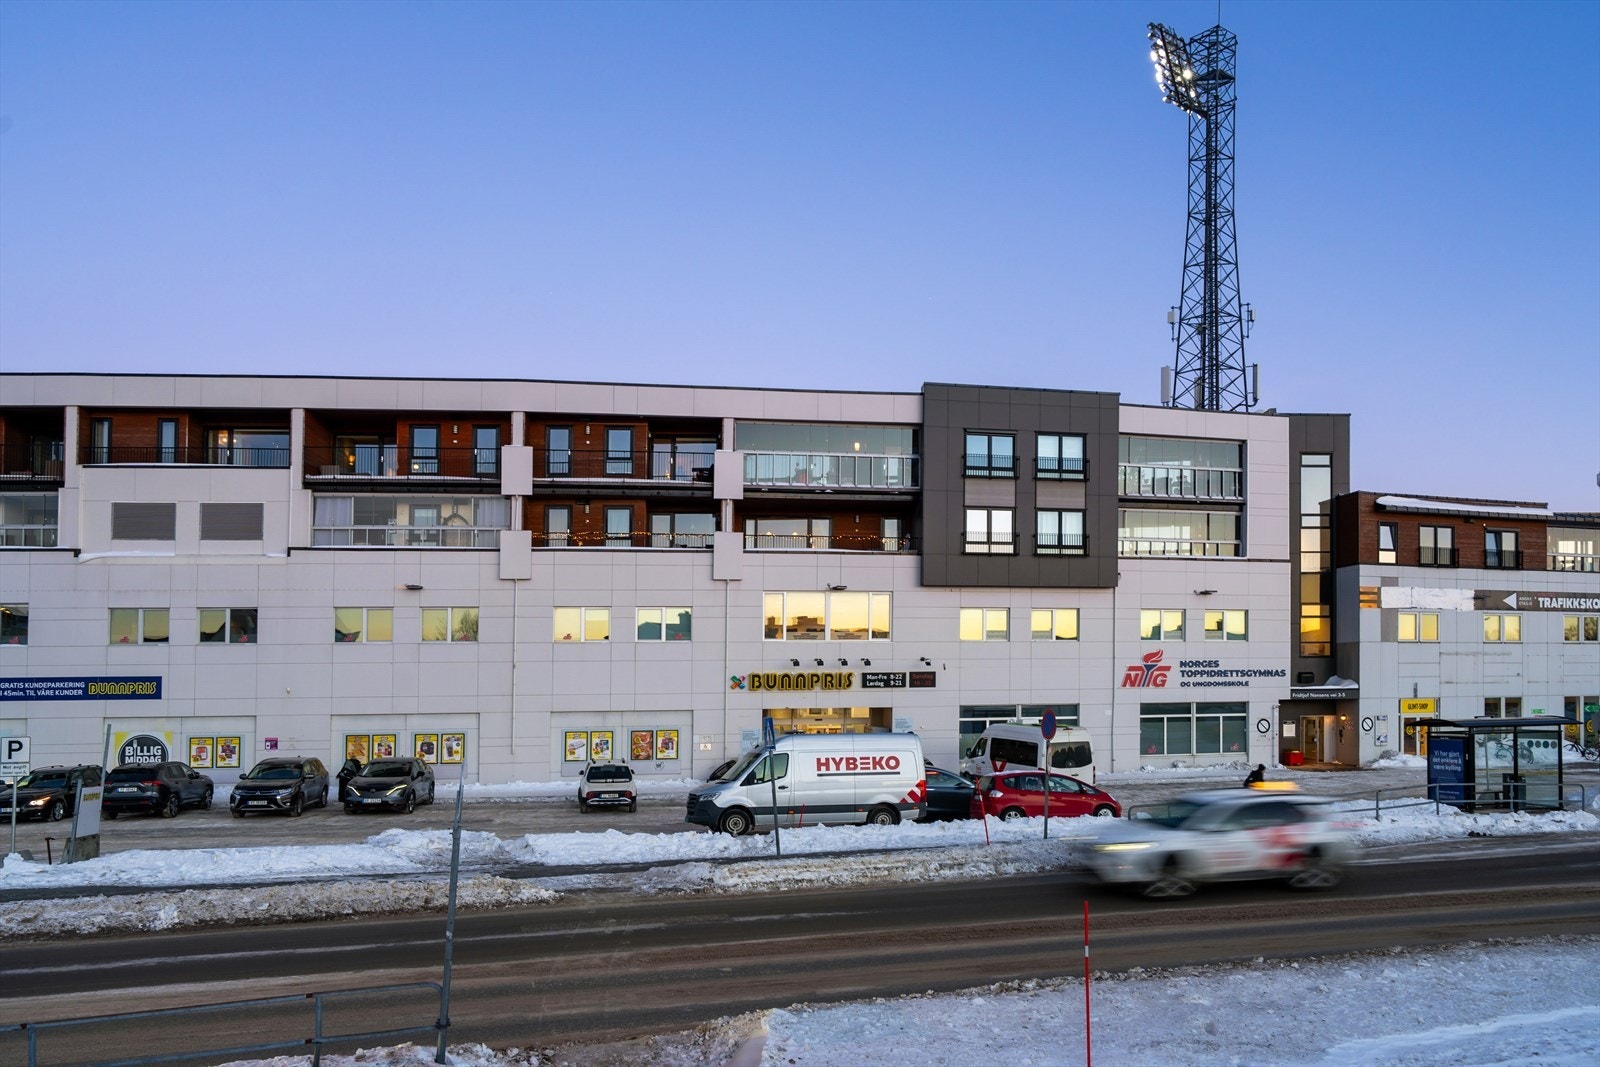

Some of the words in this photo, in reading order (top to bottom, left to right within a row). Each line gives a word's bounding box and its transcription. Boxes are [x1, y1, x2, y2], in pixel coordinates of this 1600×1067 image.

[1179, 660, 1219, 668] NORGES
[1180, 669, 1286, 678] TOPPIDRETTSGYMNAS
[749, 672, 856, 691] BUNNPRIS
[37, 688, 54, 696] VÅRE
[88, 682, 157, 695] BUNNPRIS
[8, 740, 23, 760] P
[125, 740, 162, 756] BILLIG
[125, 756, 162, 764] MIDDAG
[816, 755, 900, 772] HYBEKO
